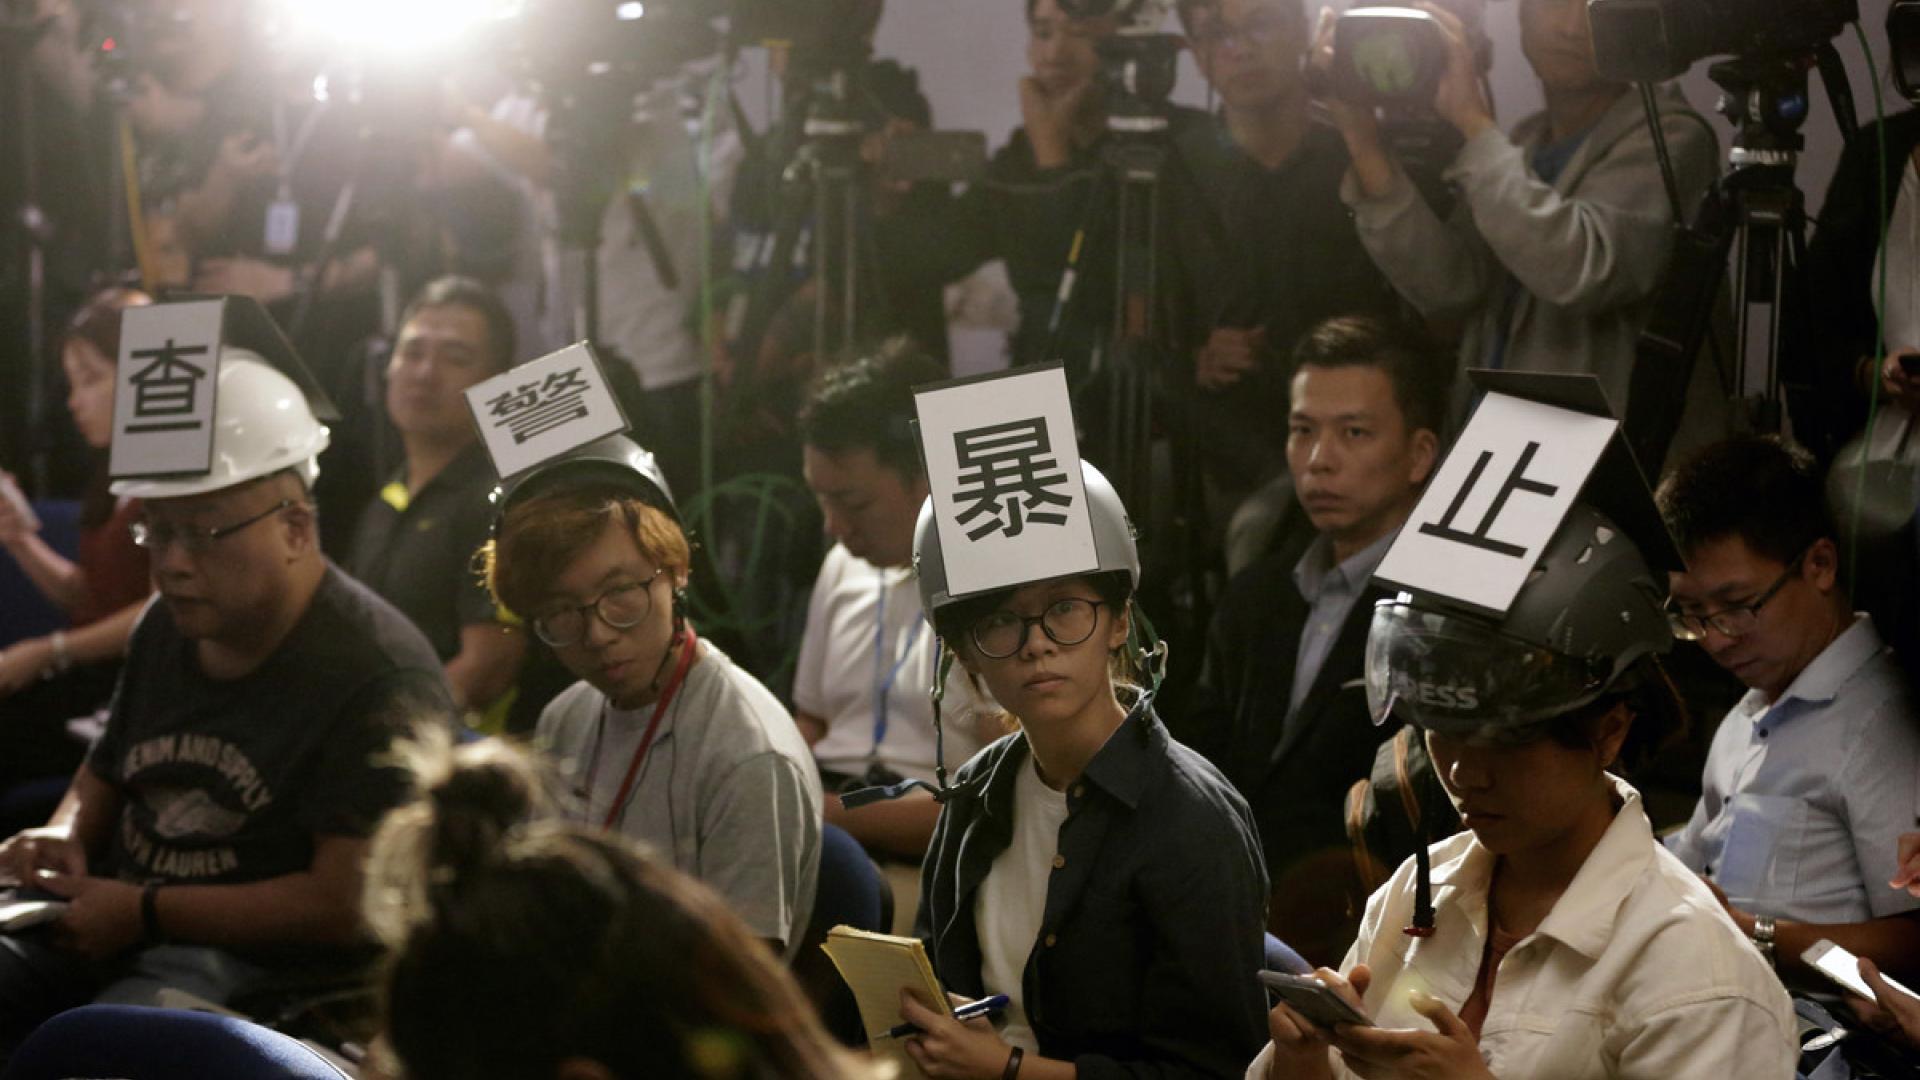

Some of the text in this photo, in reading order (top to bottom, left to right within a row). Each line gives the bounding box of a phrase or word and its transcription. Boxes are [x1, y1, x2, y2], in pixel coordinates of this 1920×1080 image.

[125, 338, 209, 434] 查
[486, 366, 590, 444] 警
[951, 415, 1074, 542] 暴
[1418, 440, 1559, 560] 止
[176, 733, 221, 766] AND
[216, 742, 272, 812] SUPPLY
[152, 846, 239, 878] LAUREN
